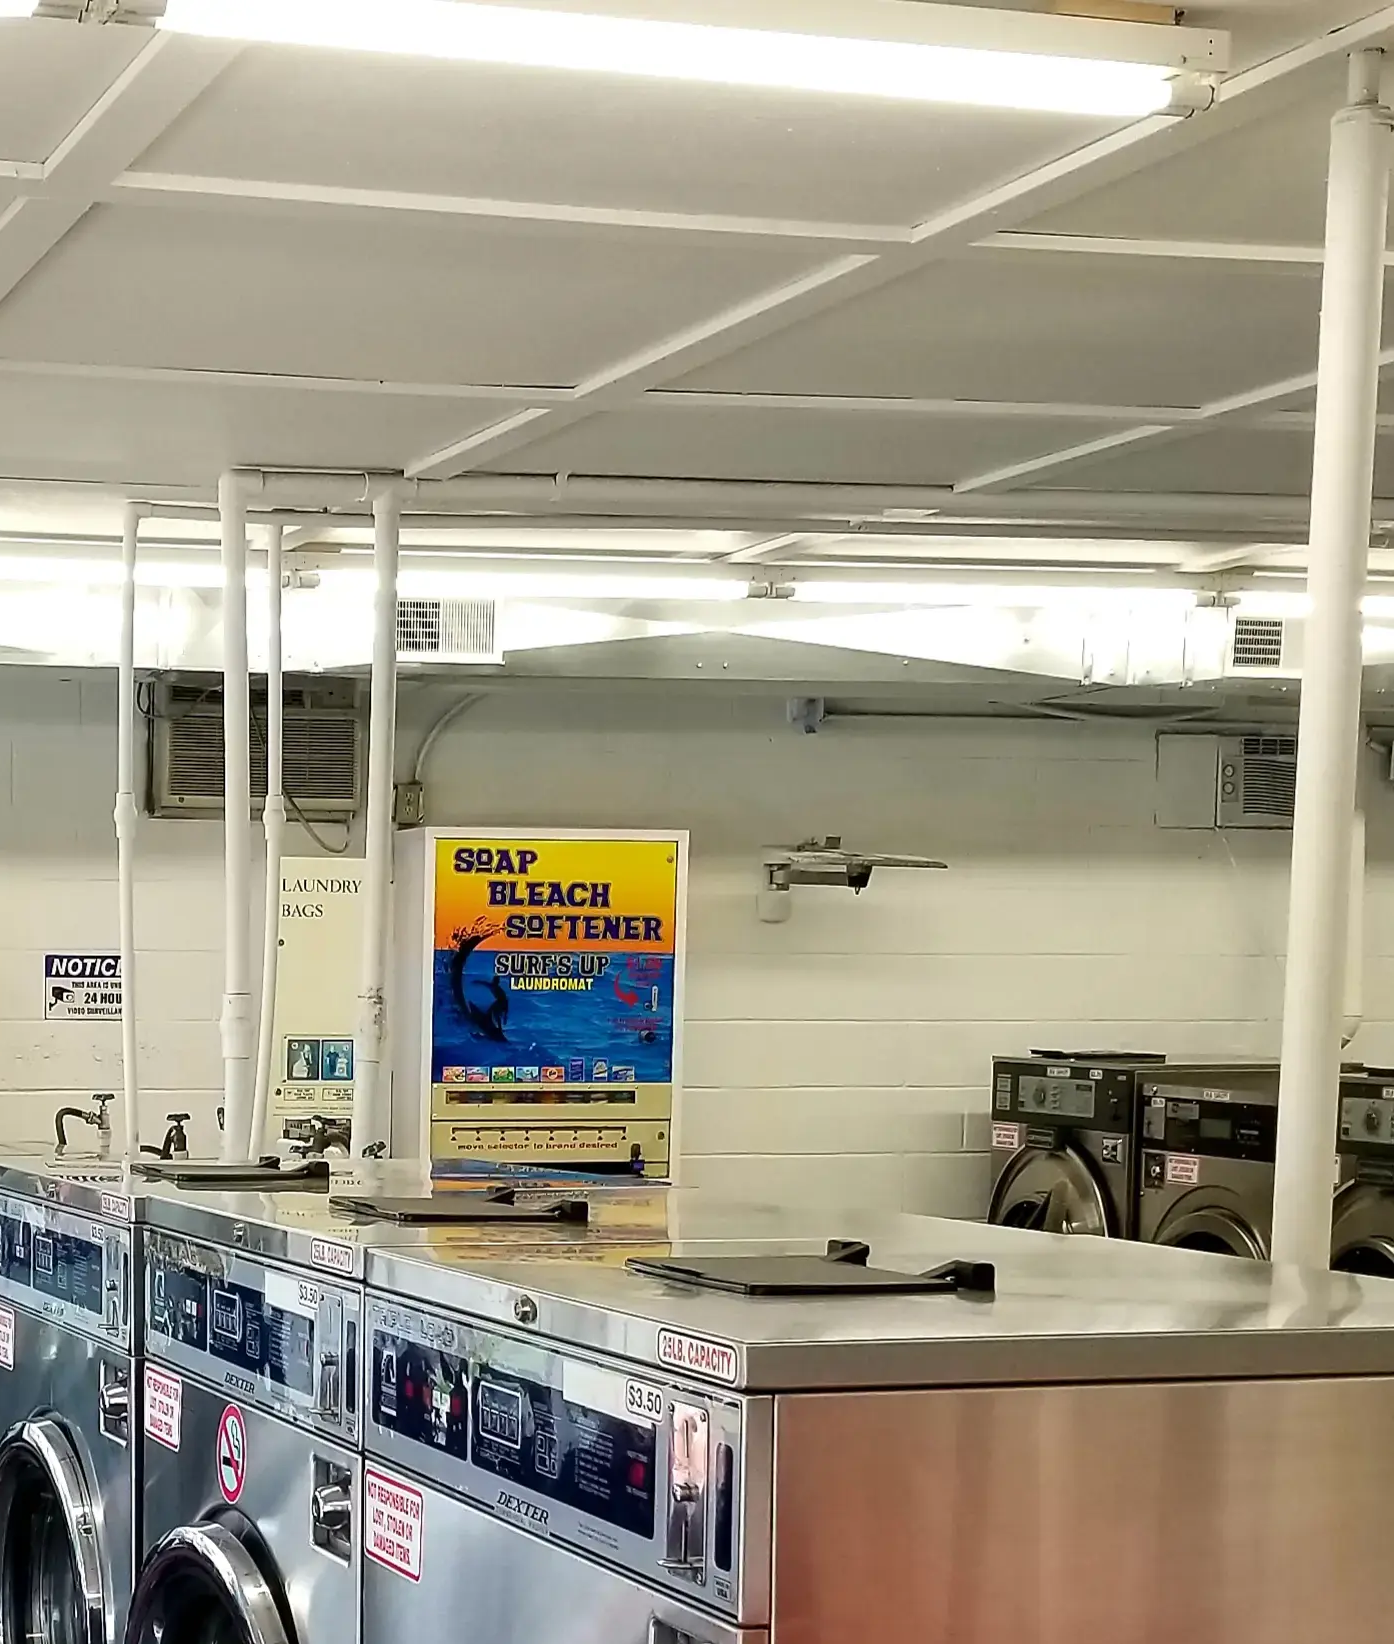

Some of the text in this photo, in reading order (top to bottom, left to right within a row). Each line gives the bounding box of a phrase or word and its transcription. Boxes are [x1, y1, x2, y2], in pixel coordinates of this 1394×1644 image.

[454, 847, 538, 874] SOAP
[282, 878, 362, 893] LAUNDRY
[487, 880, 612, 907] BLEACH
[282, 904, 323, 917] BAGS
[505, 914, 663, 941] SOFTENER
[495, 953, 574, 976] SURF'S
[579, 954, 610, 977] UP
[511, 977, 594, 990] LAUNDROMAT
[84, 992, 121, 1004] 24 HOU
[687, 1341, 732, 1375] CAPACITY
[224, 1371, 255, 1395] DEXTER
[628, 1385, 662, 1415] $3.50
[368, 1480, 420, 1520] NOT RESPONSIBLE FOR
[497, 1490, 550, 1525] DEXTER
